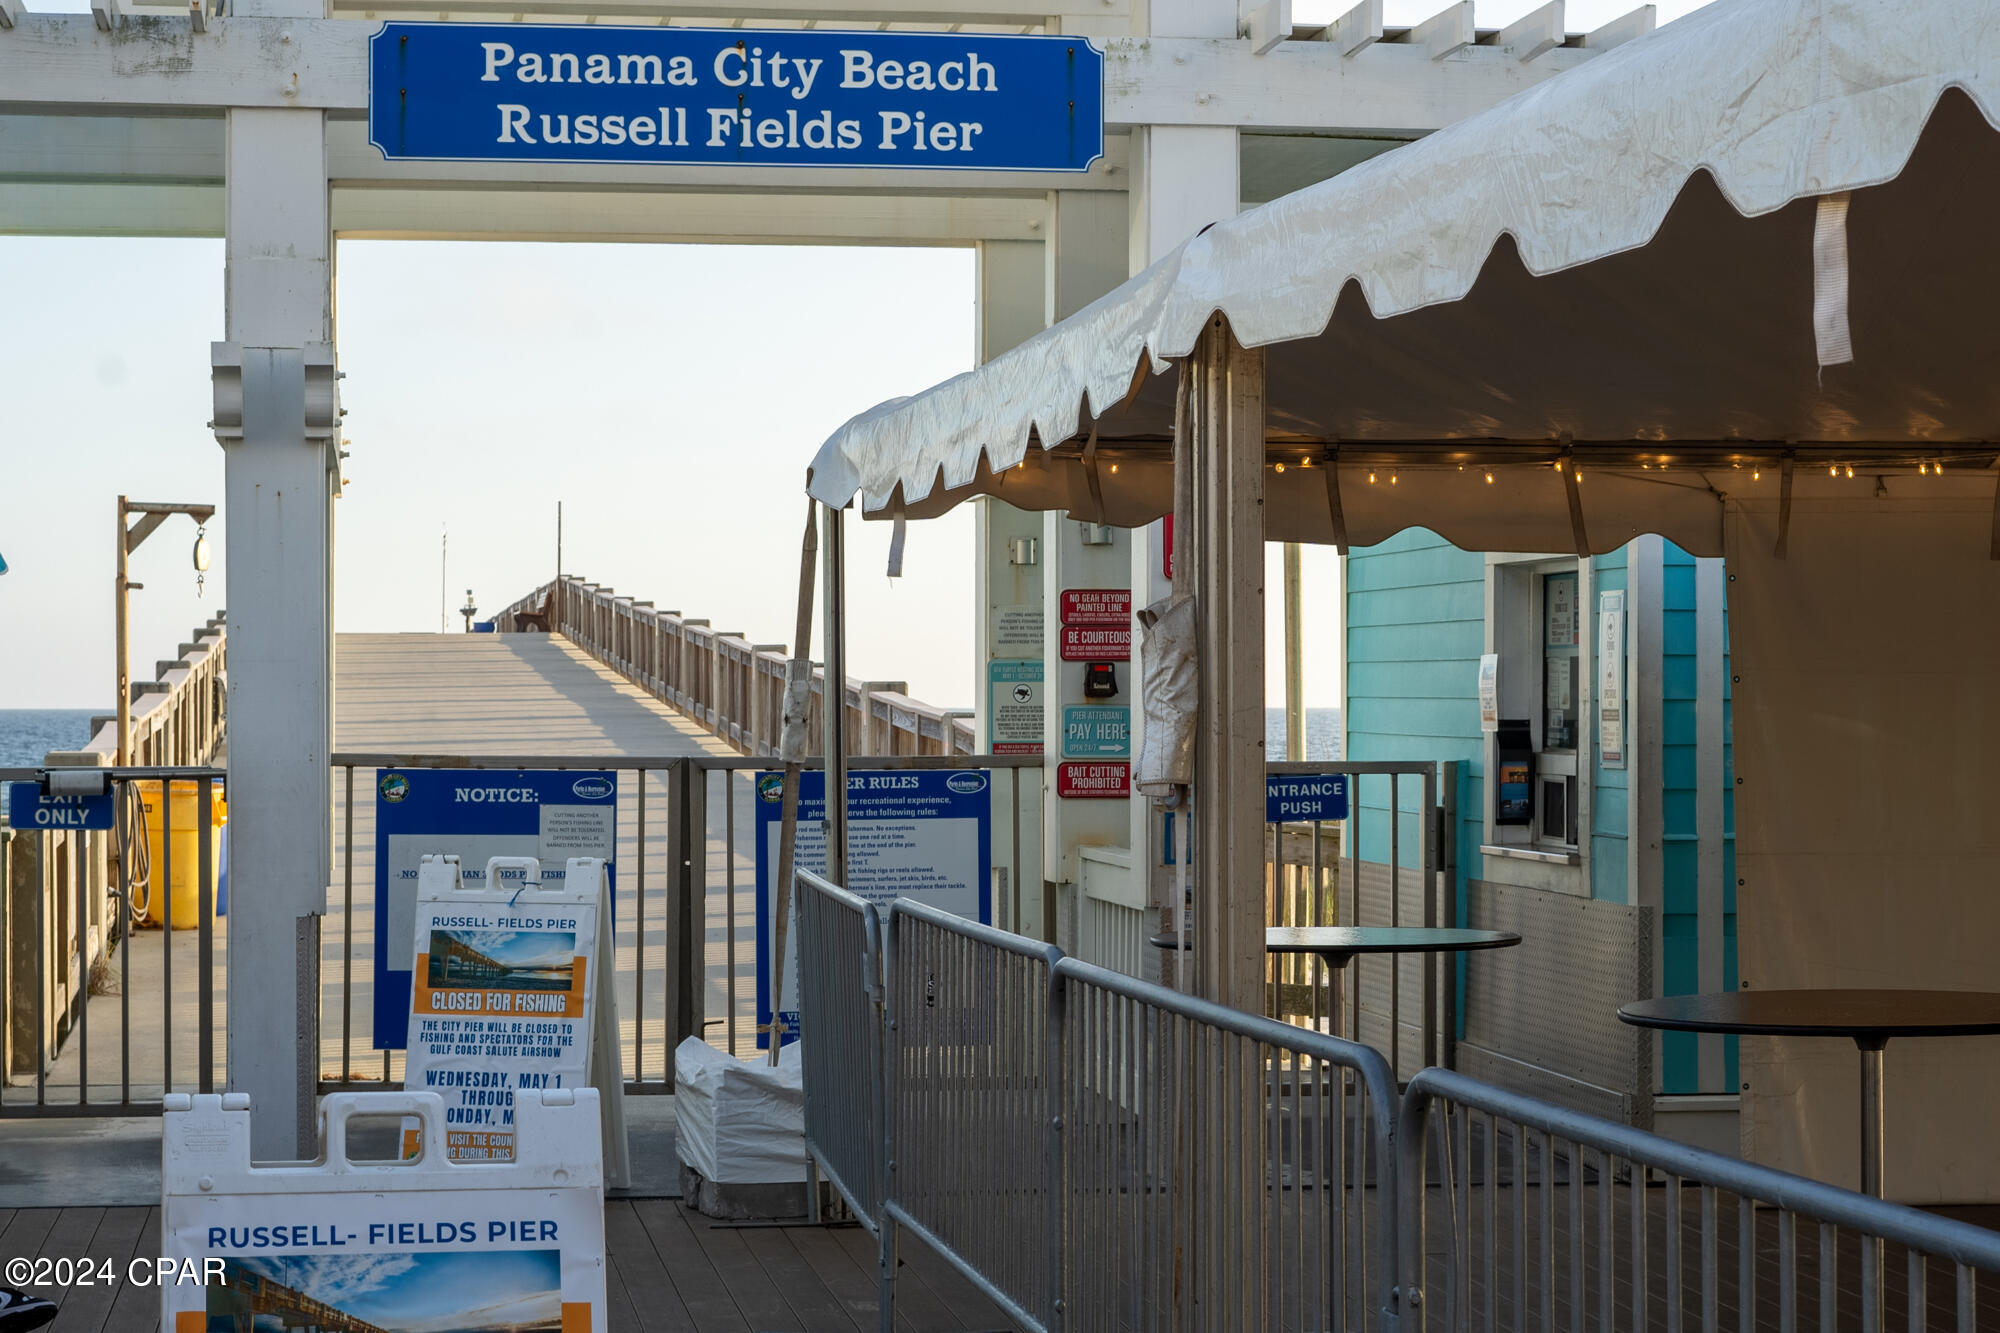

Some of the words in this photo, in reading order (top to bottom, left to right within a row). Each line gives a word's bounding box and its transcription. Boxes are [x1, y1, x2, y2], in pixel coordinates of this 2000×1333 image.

[481, 42, 698, 86] Panama
[713, 46, 823, 99] City
[840, 50, 998, 91] Beach
[497, 103, 690, 146] Russell
[706, 108, 863, 149] Fields
[878, 111, 983, 151] Pier
[1069, 594, 1079, 603] NO
[1102, 594, 1130, 603] BEYOND
[1076, 603, 1105, 612] PAINTED
[1108, 603, 1123, 612] LINE
[1068, 631, 1079, 643] BE
[1081, 631, 1131, 643] COURTEOUS
[1072, 711, 1086, 720] PIER
[1088, 711, 1123, 720] ATTENDANT
[1069, 723, 1092, 740] PAY
[1096, 723, 1126, 740] HERE
[1068, 766, 1087, 777] BAIT
[1090, 766, 1126, 778] CUTTING
[847, 777, 866, 789] ER
[869, 776, 919, 789] RULES
[1072, 778, 1121, 788] PROHIBITED
[455, 788, 539, 803] NOTICE:
[1268, 783, 1342, 797] NTRANCE
[859, 796, 905, 806] recreational
[907, 796, 951, 807] experience,
[1281, 801, 1322, 814] PUSH
[35, 808, 90, 825] ONLY
[866, 808, 878, 817] the
[880, 807, 916, 819] following
[918, 807, 938, 817] rules:
[402, 870, 417, 879] NO
[432, 917, 493, 928] RUSSELL-
[497, 918, 543, 928] FIELDS
[547, 919, 577, 929] PIER
[431, 991, 482, 1010] CLOSED
[486, 993, 511, 1011] FOR
[514, 993, 566, 1013] FISHING
[422, 1021, 438, 1031] THE
[441, 1021, 460, 1032] CITY
[464, 1022, 484, 1032] PIER
[487, 1022, 508, 1033] WILL
[511, 1023, 522, 1033] BE
[525, 1023, 557, 1034] CLOSED
[562, 1024, 573, 1034] TO
[420, 1033, 455, 1043] FISHING
[458, 1034, 475, 1043] AND
[479, 1034, 534, 1045] SPECTATORS
[537, 1035, 553, 1045] FOR
[557, 1036, 573, 1046] THE
[430, 1045, 451, 1054] GULF
[455, 1046, 482, 1055] COAST
[486, 1047, 518, 1057] SALUTE
[521, 1047, 561, 1058] AIRSHOW
[426, 1070, 513, 1089] WEDNESDAY,
[519, 1073, 549, 1089] MAY
[555, 1074, 562, 1089] 1
[461, 1090, 513, 1106] THROUG
[447, 1108, 496, 1126] ONDAY,
[450, 1133, 470, 1145] VISIT
[473, 1134, 488, 1145] THE
[459, 1147, 489, 1158] DURING
[207, 1226, 357, 1248] RUSSELL-
[368, 1222, 477, 1245] FIELDS
[487, 1220, 559, 1243] PIER
